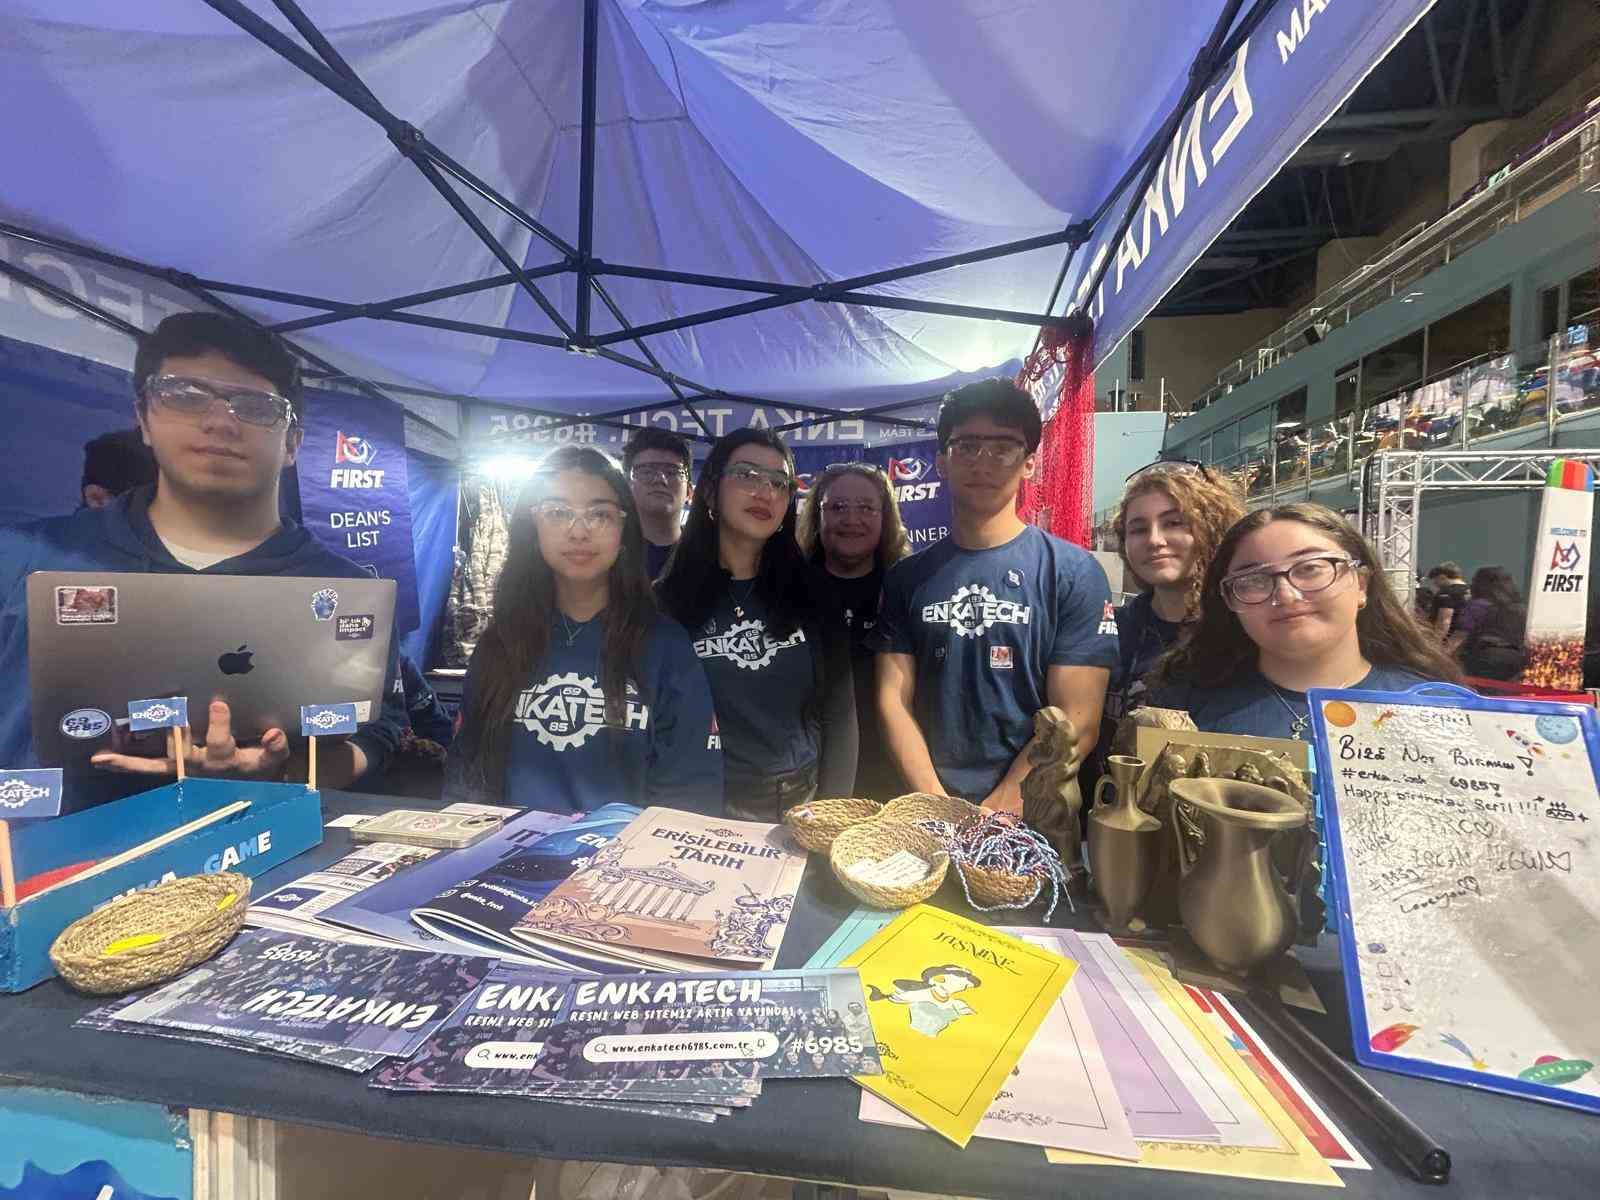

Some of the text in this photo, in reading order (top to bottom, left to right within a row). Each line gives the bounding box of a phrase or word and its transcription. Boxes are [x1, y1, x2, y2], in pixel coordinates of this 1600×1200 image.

[330, 469, 385, 488] FIRST
[891, 482, 941, 503] IRST
[330, 510, 392, 529] DEAN'S
[347, 530, 380, 548] LIST
[907, 526, 950, 543] NNER
[1543, 574, 1584, 592] FIRST
[922, 601, 1031, 625] ENKATECH
[562, 687, 581, 696] 69
[550, 721, 569, 732] 85
[1343, 783, 1390, 807] Happy
[203, 830, 272, 874] GAME
[932, 931, 1022, 977] JASMINE
[574, 979, 762, 1006] ENKATECH
[240, 987, 439, 1030] ENKATECH
[613, 1009, 640, 1020] WEB
[696, 1007, 734, 1019] ARTIK
[507, 1017, 534, 1028] WEB
[611, 1040, 750, 1054] www.enkatech6985.com.tr
[790, 1035, 864, 1055] #6985
